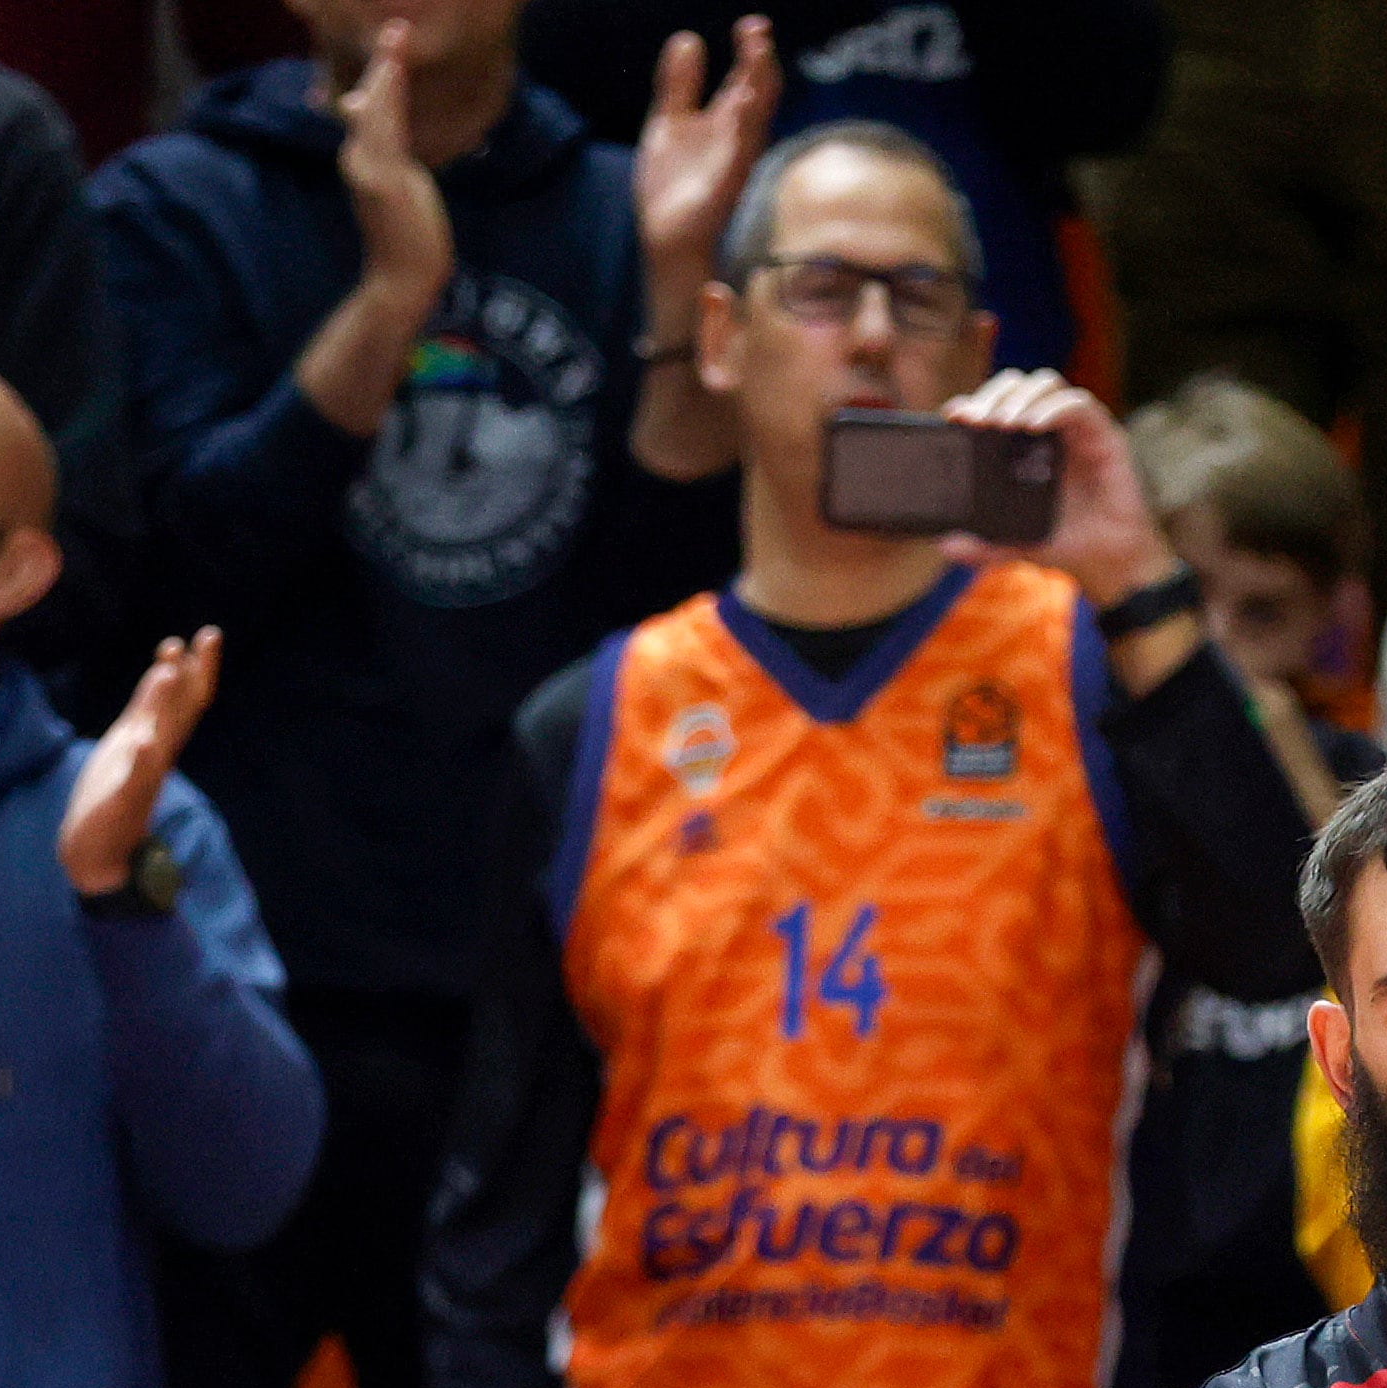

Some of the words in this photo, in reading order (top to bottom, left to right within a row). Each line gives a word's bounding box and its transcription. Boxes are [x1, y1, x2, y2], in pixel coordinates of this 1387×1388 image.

[772, 901, 886, 1040] 14
[644, 1104, 946, 1192] Cultura
[641, 1187, 1021, 1282] Esfuerzo
